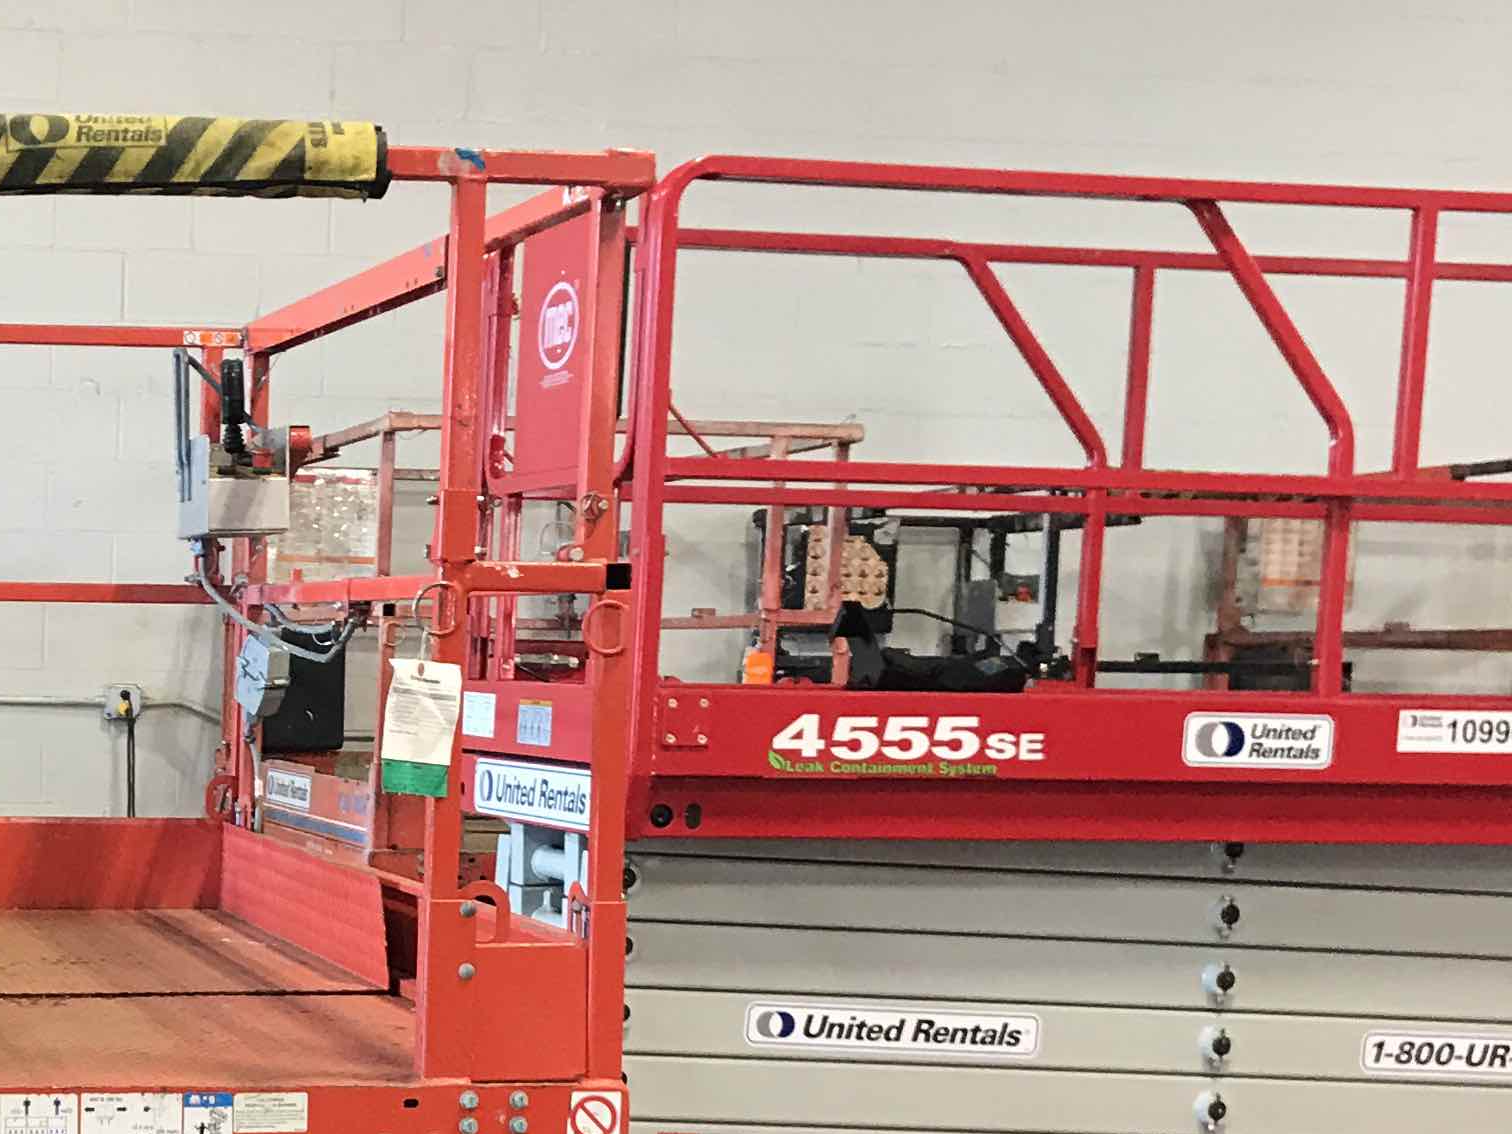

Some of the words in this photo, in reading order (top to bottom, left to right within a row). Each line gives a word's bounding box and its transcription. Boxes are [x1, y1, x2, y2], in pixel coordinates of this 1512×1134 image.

[76, 125, 163, 142] Rentals
[1251, 723, 1318, 741] United
[1448, 718, 1512, 744] 1099
[1249, 742, 1321, 760] Rentals
[496, 773, 537, 807] United
[538, 779, 587, 815] Rentals
[802, 1014, 907, 1042] United
[911, 1018, 1022, 1047] Rentals
